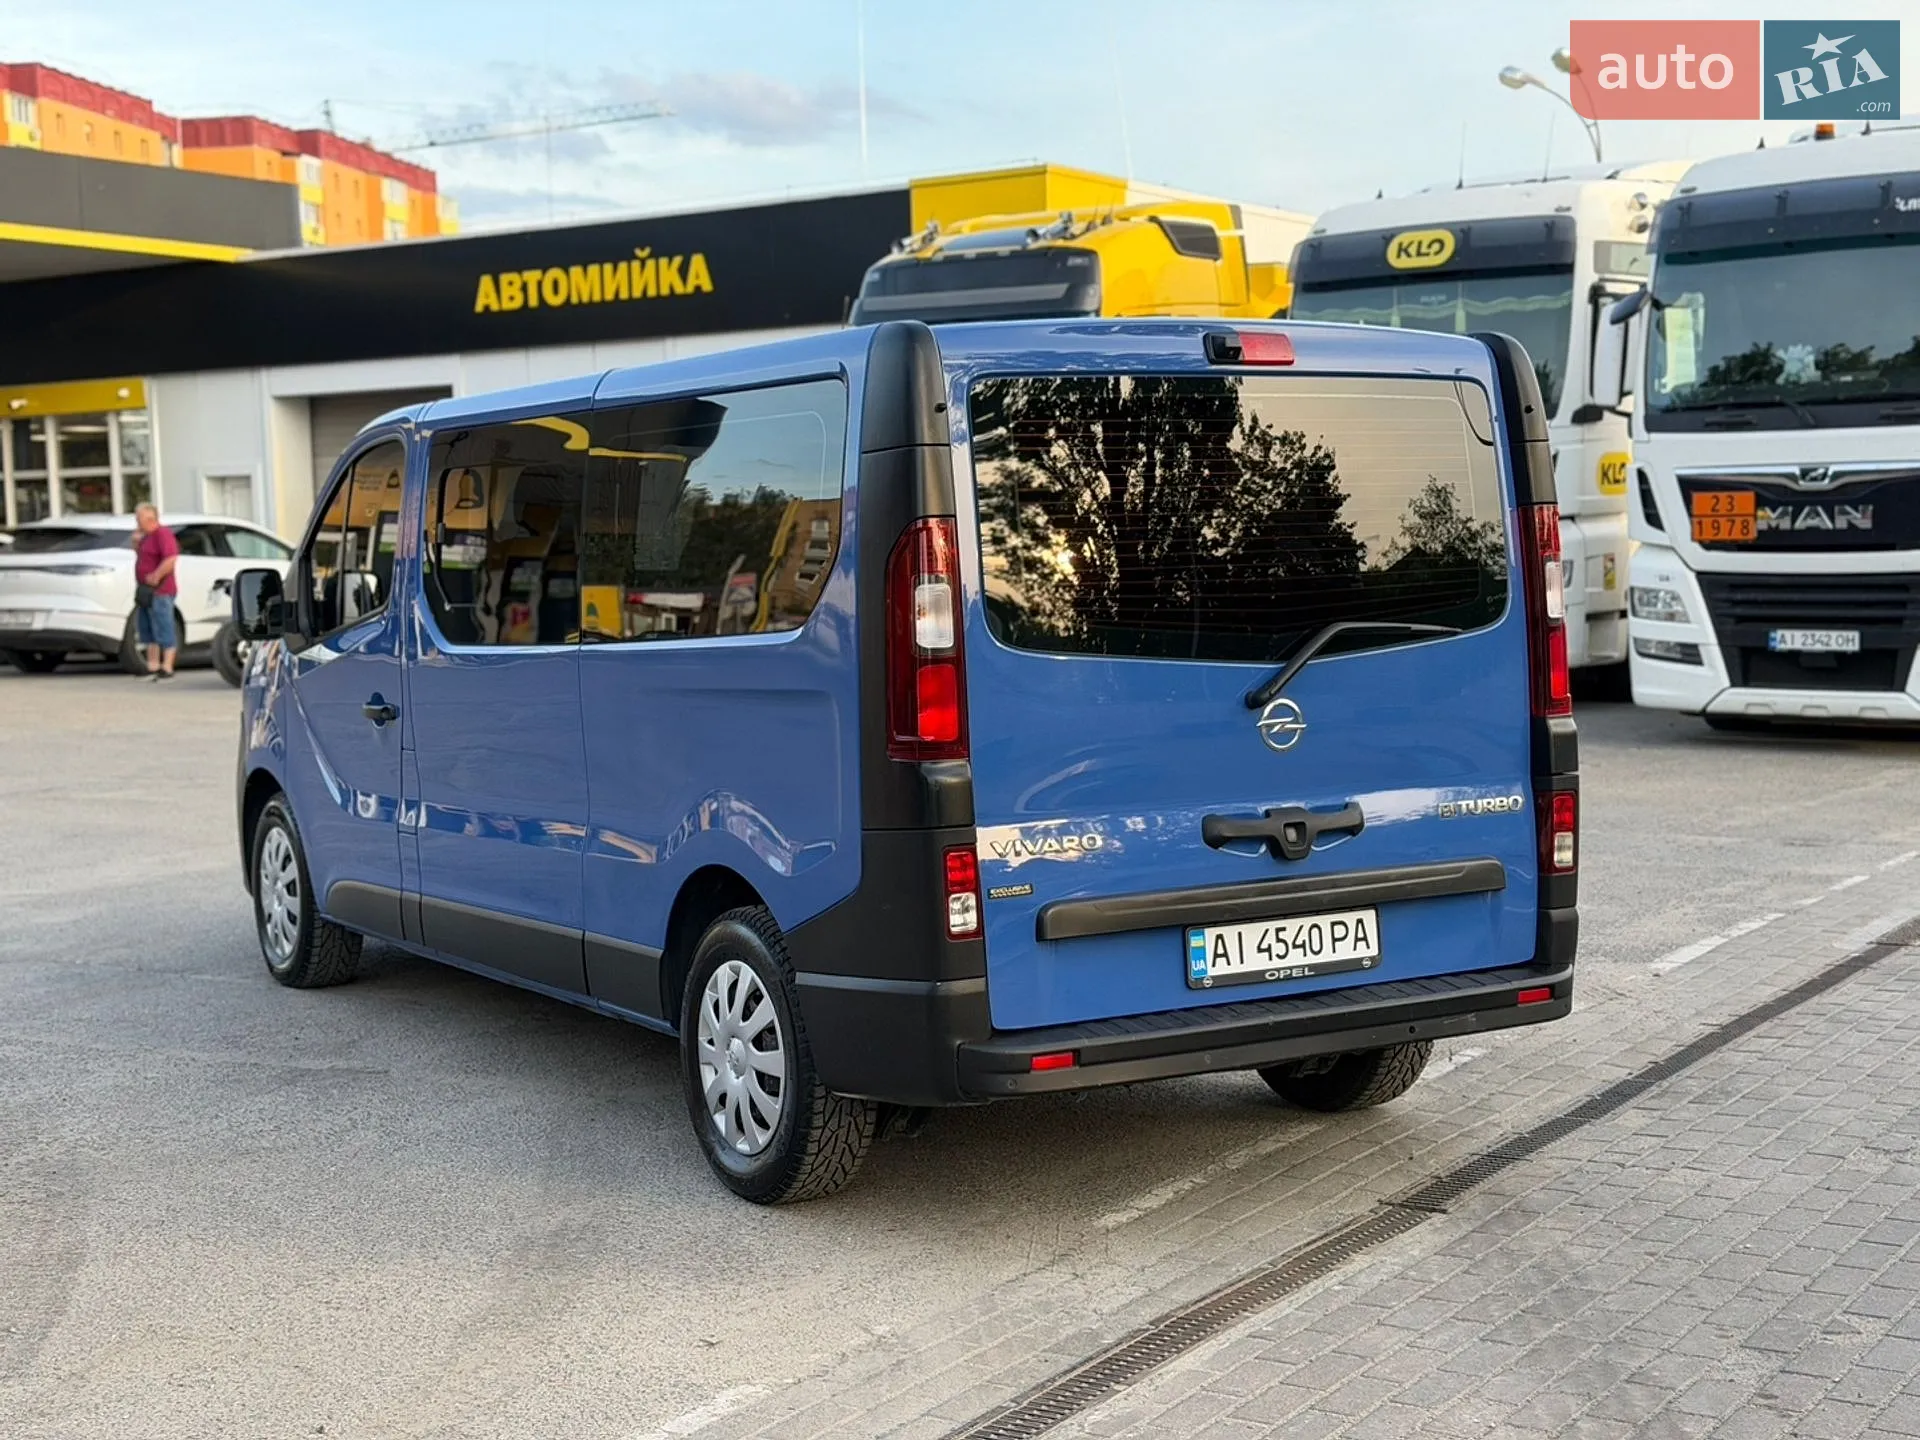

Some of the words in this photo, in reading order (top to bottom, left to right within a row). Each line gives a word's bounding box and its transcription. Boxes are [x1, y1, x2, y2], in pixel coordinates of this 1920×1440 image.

[1396, 237, 1445, 260] KLO
[474, 246, 714, 314] АВТОМИЙКА
[1710, 494, 1735, 513] 23
[1696, 519, 1750, 537] 1978
[1757, 505, 1873, 531] MAN
[1801, 633, 1832, 647] 2342
[1835, 634, 1856, 647] OH
[989, 833, 1104, 859] VIVARO
[1211, 931, 1244, 968] AI
[1256, 922, 1323, 962] 4540
[1329, 917, 1371, 955] PA
[1191, 960, 1207, 972] UA
[1264, 967, 1315, 980] OPEL
